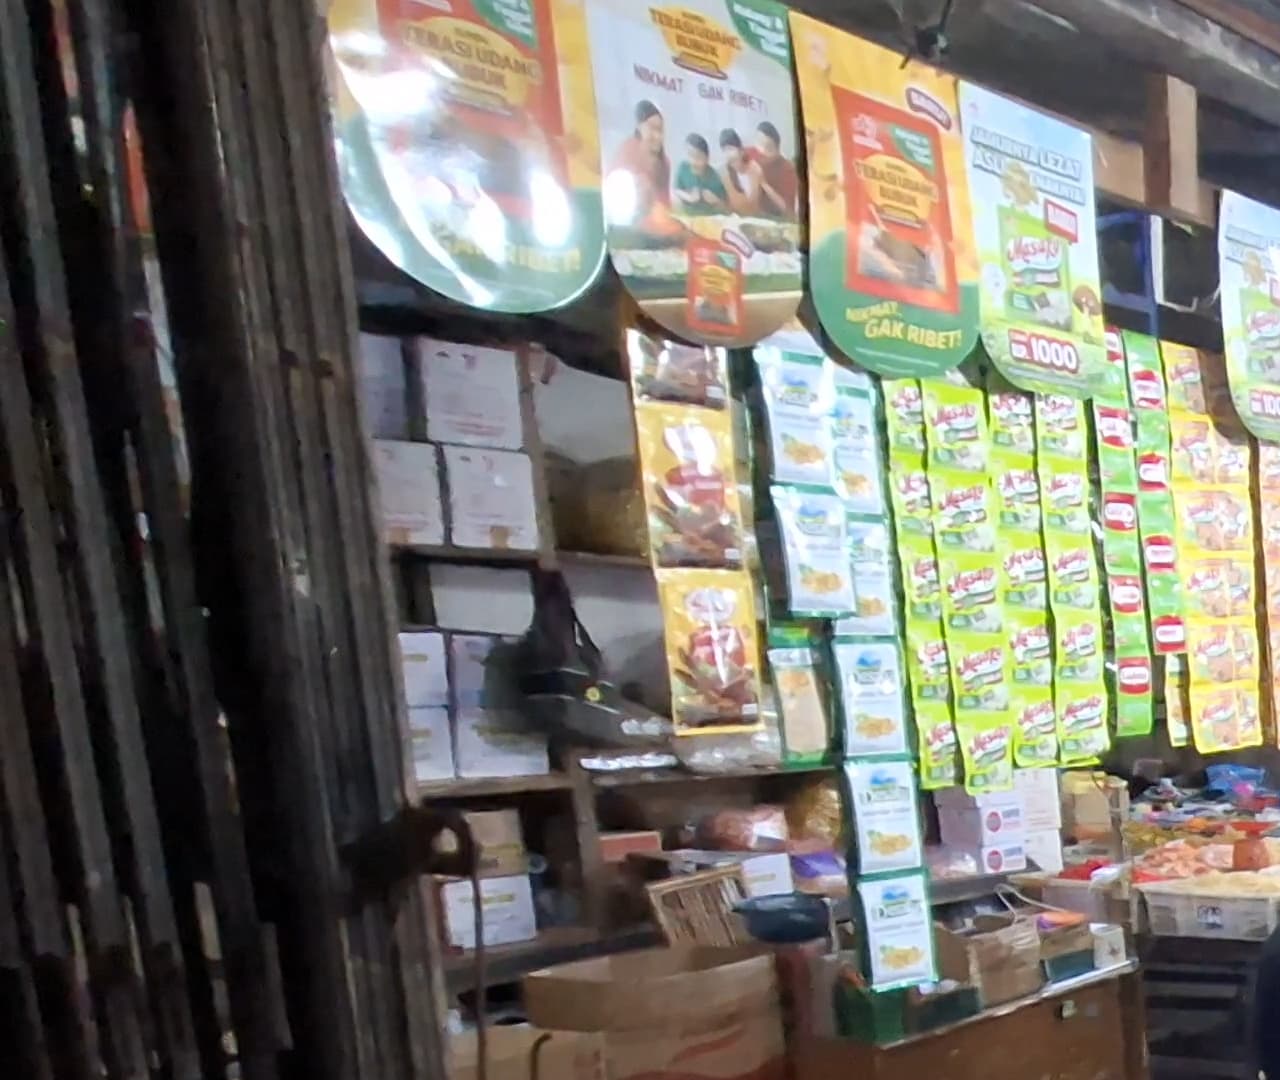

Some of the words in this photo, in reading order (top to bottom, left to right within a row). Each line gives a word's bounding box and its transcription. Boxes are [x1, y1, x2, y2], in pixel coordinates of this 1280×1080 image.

[633, 63, 684, 94] NIKMAT
[864, 318, 905, 340] GAK
[906, 324, 963, 350] RIBET!
[1029, 335, 1079, 371] 1000
